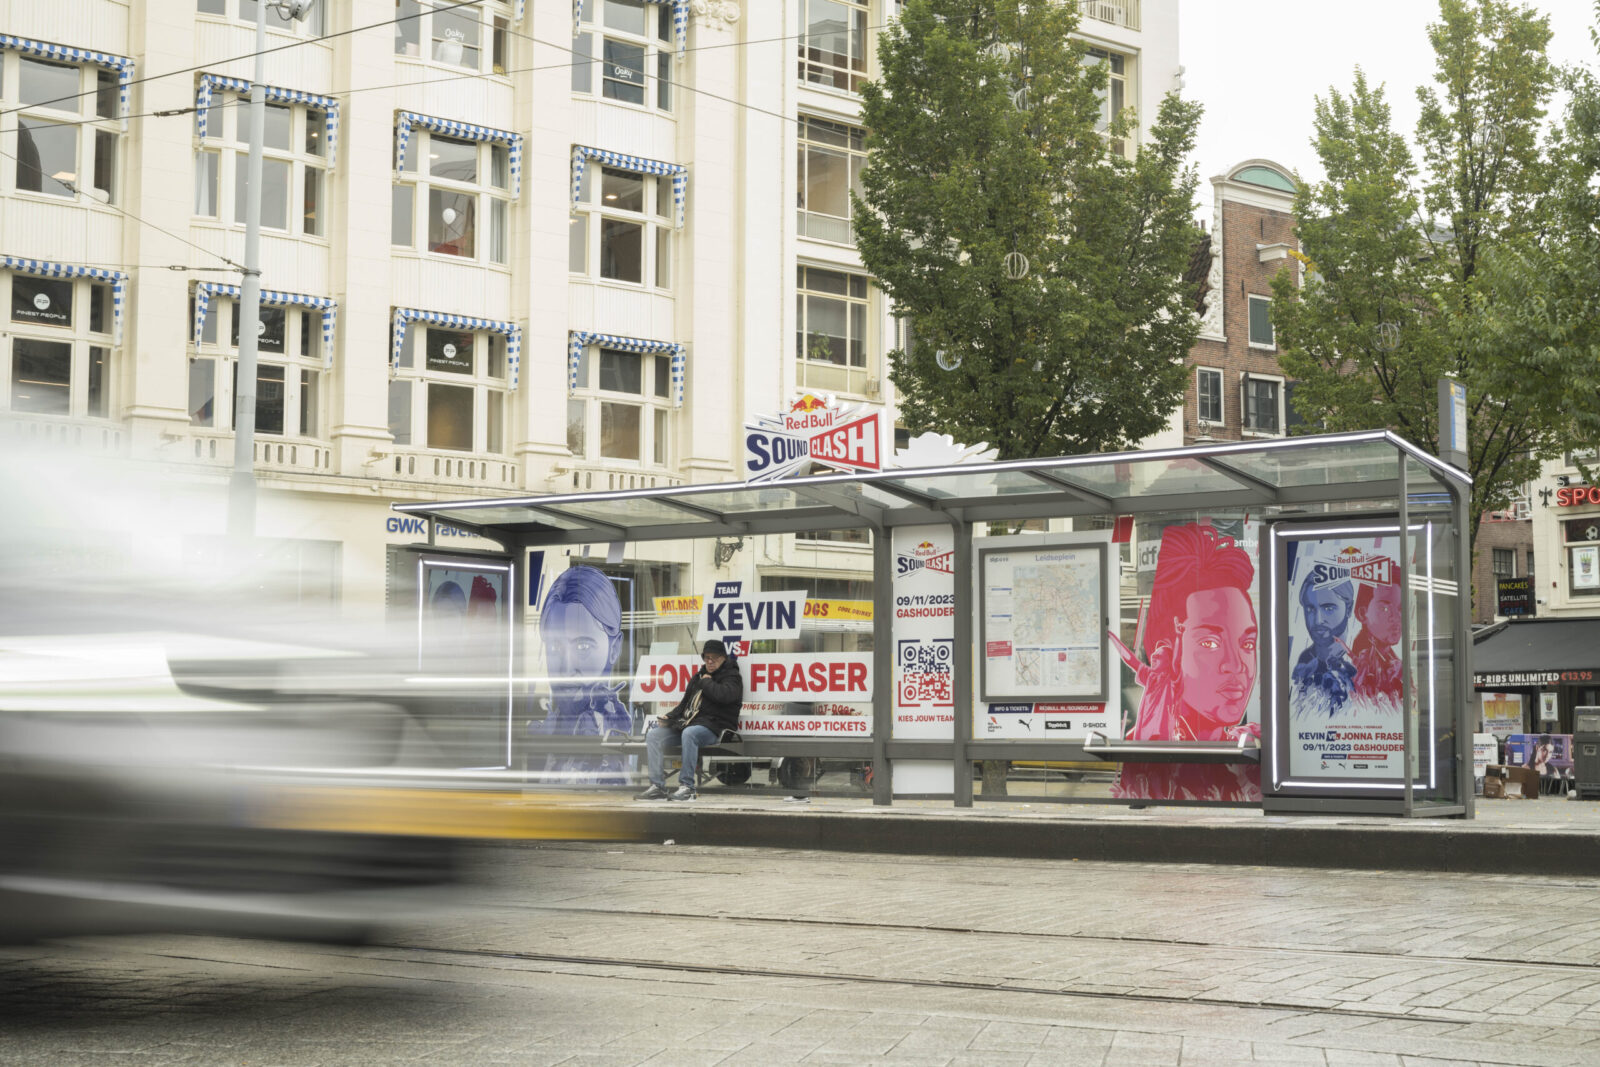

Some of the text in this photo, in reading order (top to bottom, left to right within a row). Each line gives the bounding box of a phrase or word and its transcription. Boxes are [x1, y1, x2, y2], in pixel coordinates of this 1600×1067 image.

[614, 66, 632, 78] Oaky
[16, 309, 40, 317] FINEST
[786, 412, 833, 430] Red Bull
[746, 420, 876, 472] SOUND CLASH
[386, 518, 425, 534] GWK
[898, 554, 954, 573] SOUND CLASH
[1035, 554, 1076, 562] Leidseplein
[1314, 560, 1388, 583] SOUND CLASH
[717, 586, 738, 594] TEAM
[1499, 582, 1528, 590] PANCAKES
[896, 595, 954, 606] 09/11/2023
[707, 600, 796, 632] KEVIN
[896, 607, 954, 618] GASHOUDER
[724, 641, 745, 655] VS.
[750, 662, 868, 692] FRASER
[1509, 673, 1559, 682] UNLIMITED
[745, 721, 775, 731] MAAK
[778, 721, 805, 731] KANS
[807, 721, 820, 731] OP
[823, 721, 866, 731] TICKETS
[1303, 743, 1351, 752] 09/11/2023
